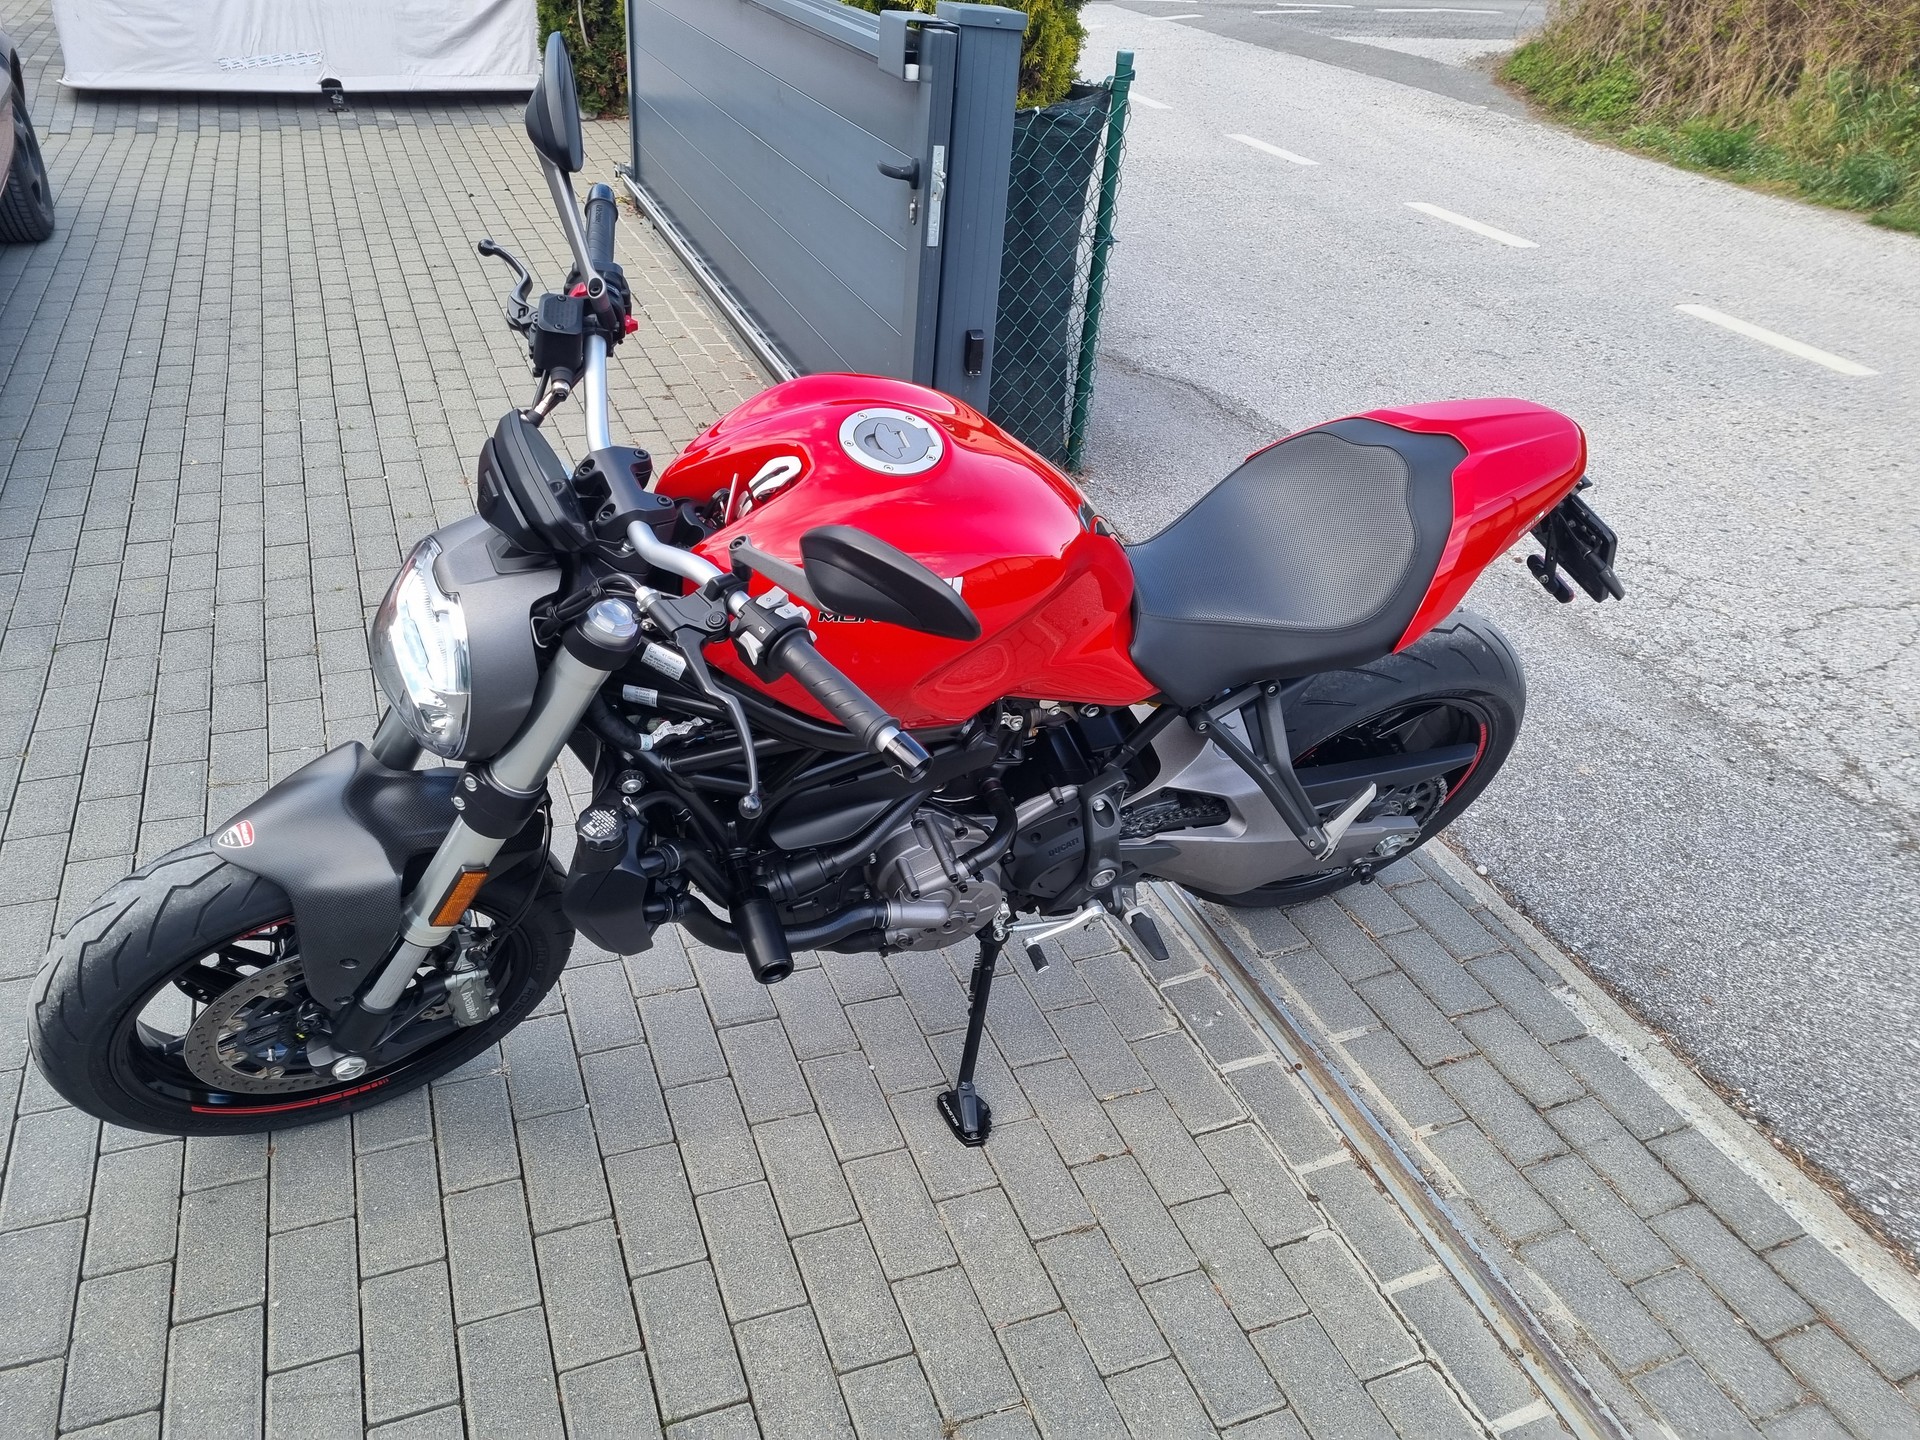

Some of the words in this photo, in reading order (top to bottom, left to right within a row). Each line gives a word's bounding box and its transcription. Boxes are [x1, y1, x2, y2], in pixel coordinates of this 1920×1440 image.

[1048, 837, 1080, 857] DUCATI
[458, 988, 479, 1019] brembo
[942, 1101, 960, 1127] MONSTER
